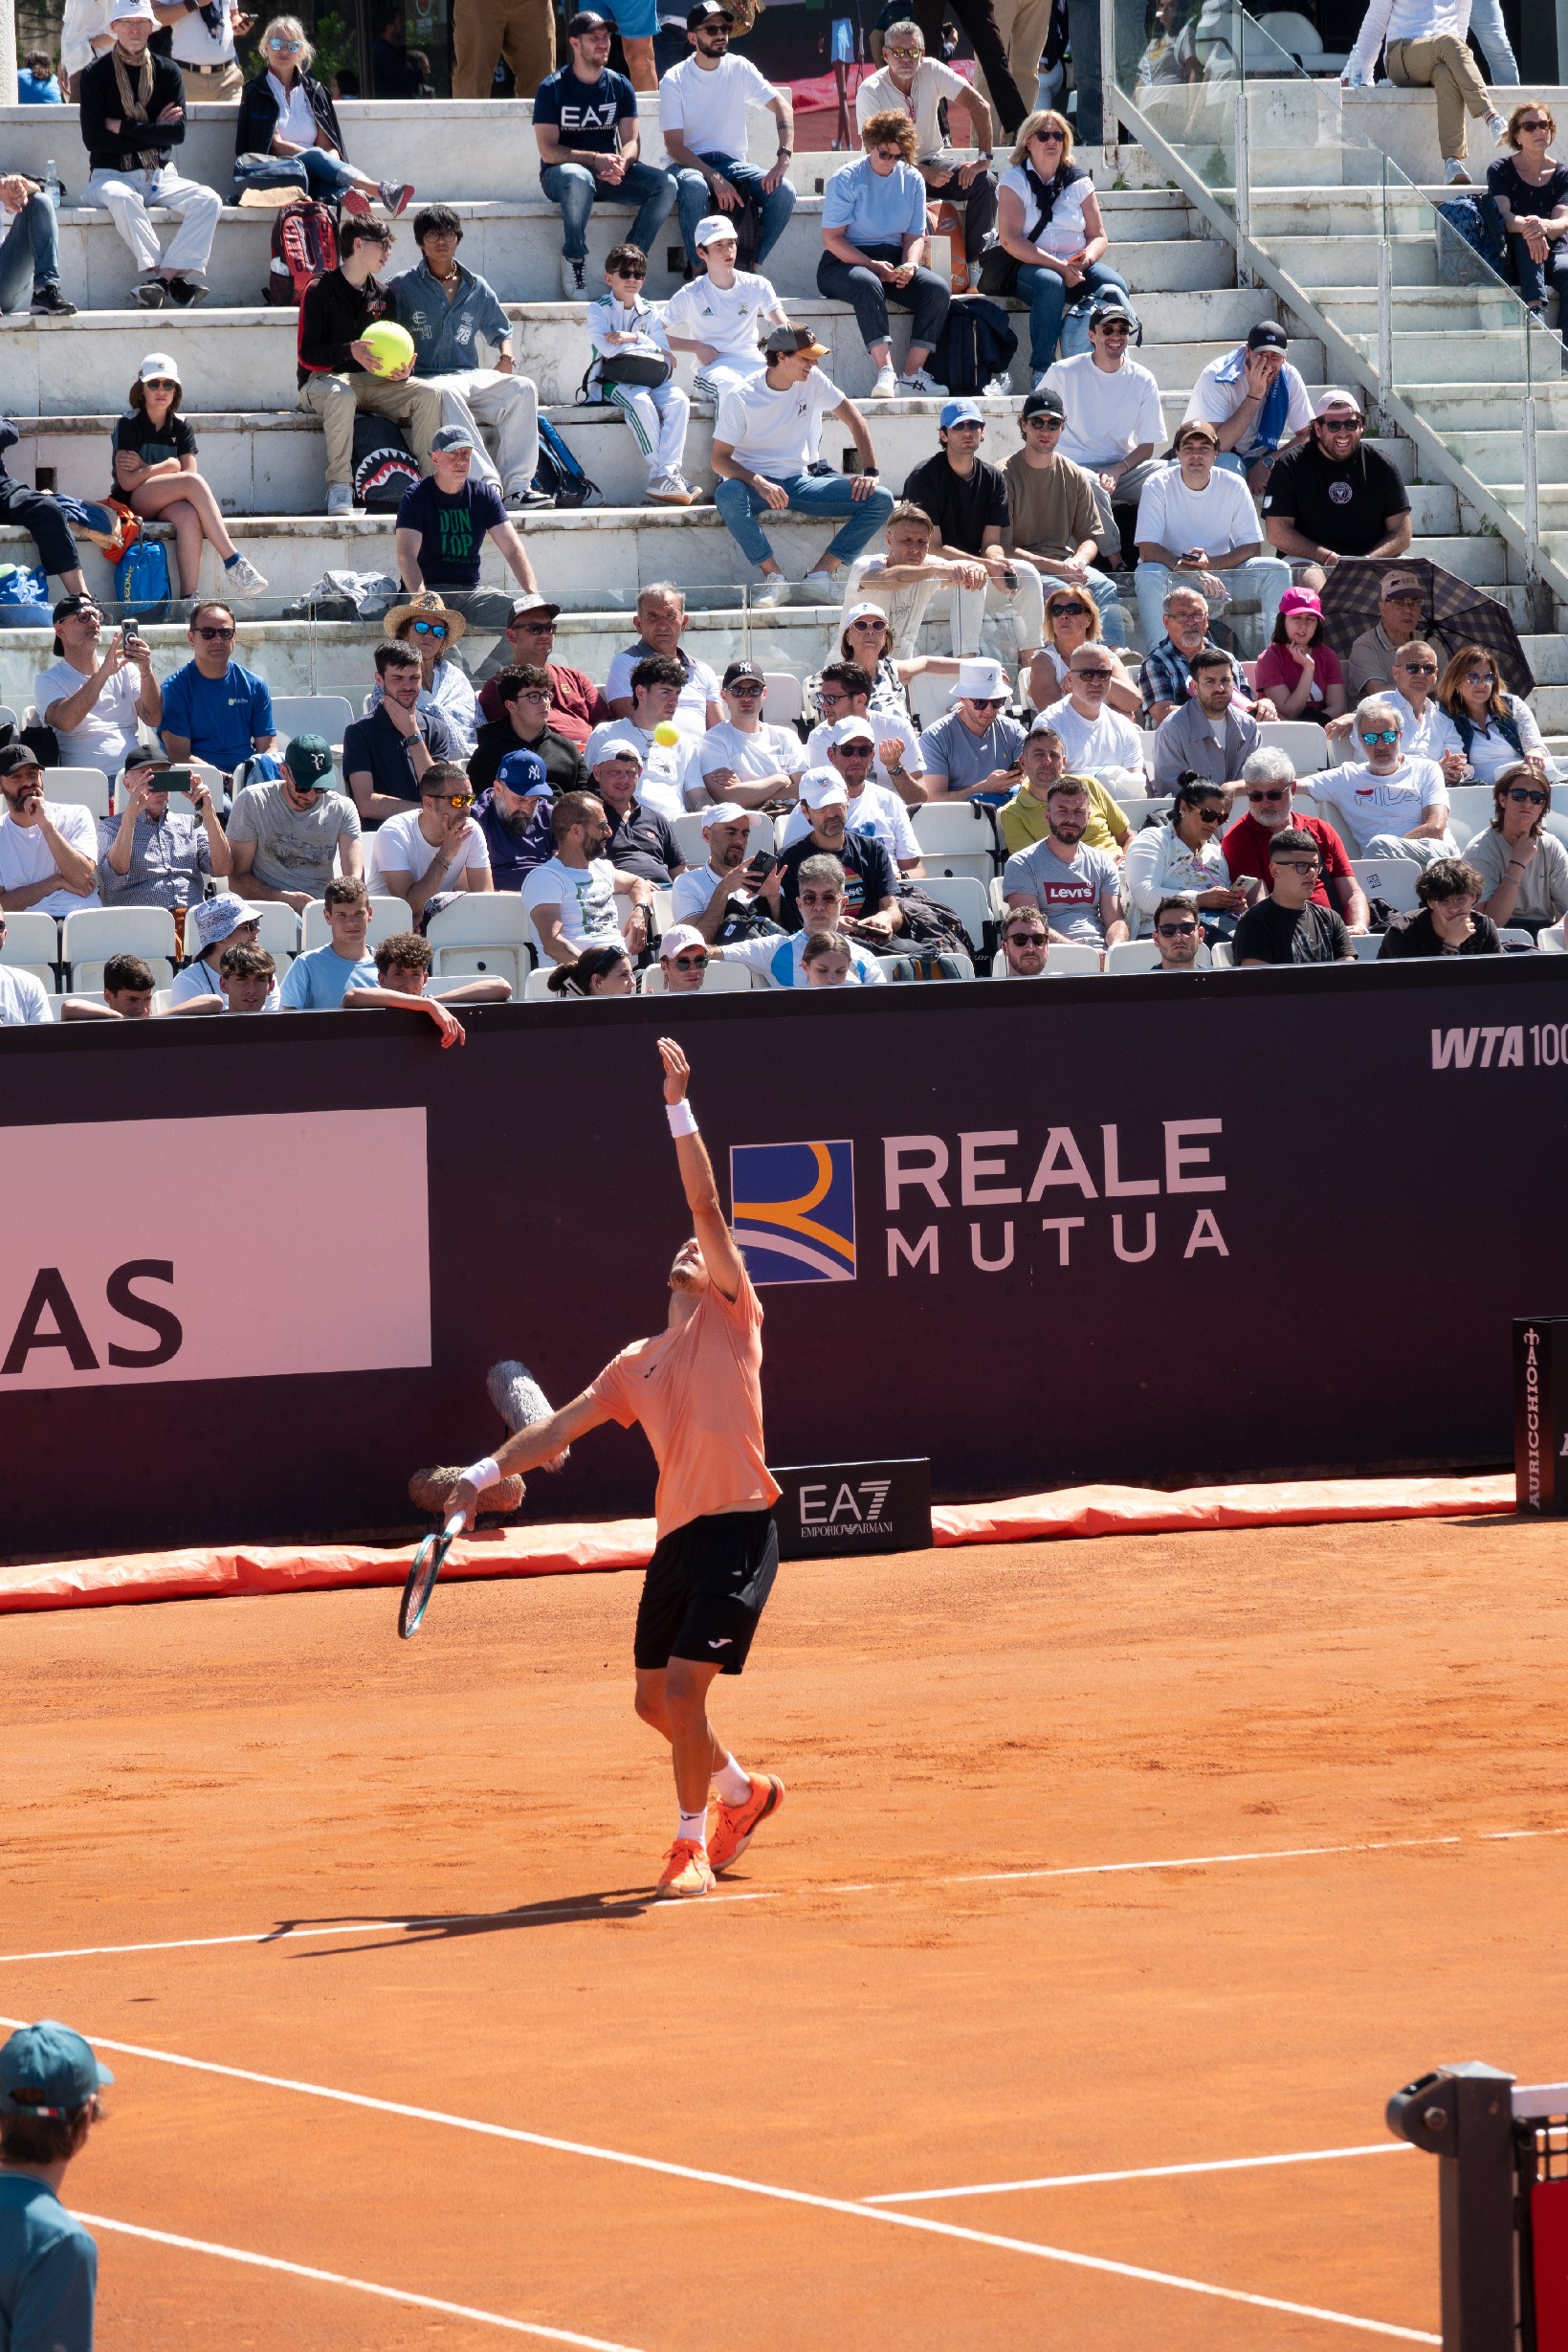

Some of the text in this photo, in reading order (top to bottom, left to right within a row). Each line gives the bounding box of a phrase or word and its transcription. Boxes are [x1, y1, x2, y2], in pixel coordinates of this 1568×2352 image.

[561, 102, 617, 127] EA7
[439, 508, 472, 533] DUN
[442, 534, 474, 556] LOP
[1355, 786, 1421, 806] FILA
[1431, 1026, 1524, 1070] WTA
[881, 1119, 1226, 1210] REALE
[885, 1209, 1229, 1276] MUTUA
[0, 1258, 183, 1375] AS
[1527, 1365, 1540, 1511] AURICCHIO
[799, 1479, 892, 1524] EA7
[801, 1521, 893, 1538] EMPORIO ARMANI
